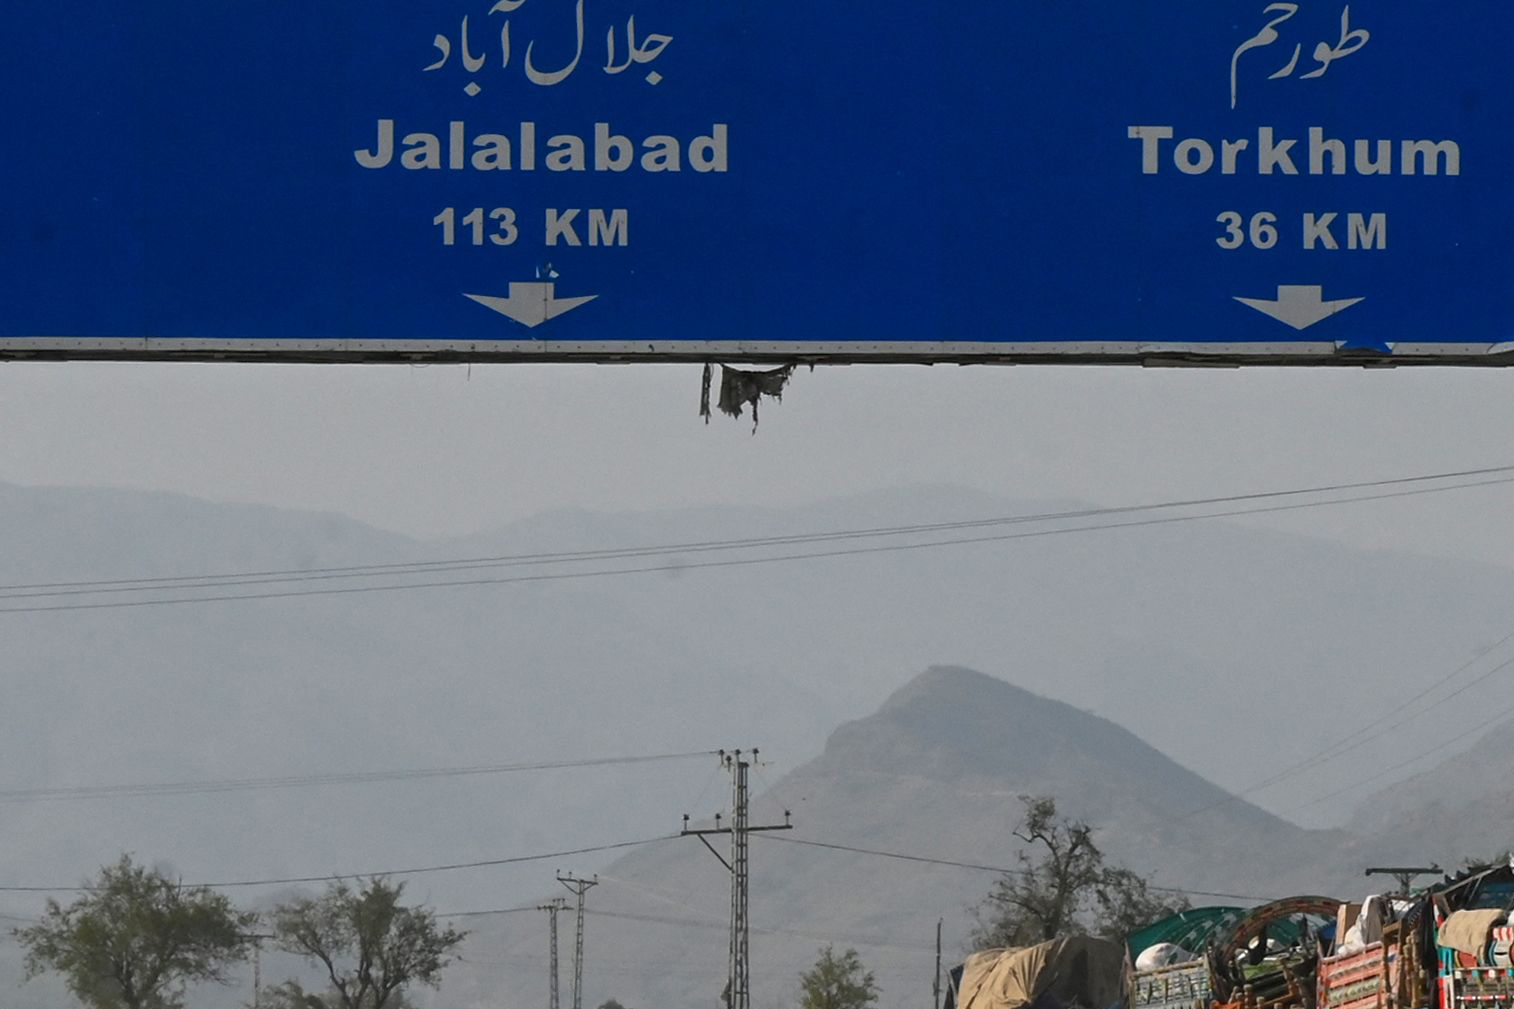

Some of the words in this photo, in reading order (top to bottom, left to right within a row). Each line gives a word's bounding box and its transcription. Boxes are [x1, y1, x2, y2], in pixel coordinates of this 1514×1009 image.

[354, 119, 728, 173] Jalalabad
[1127, 125, 1461, 176] Torkhum
[433, 207, 519, 246] 113
[545, 208, 628, 246] KM
[1216, 211, 1278, 250] 36
[1303, 212, 1387, 250] KM
